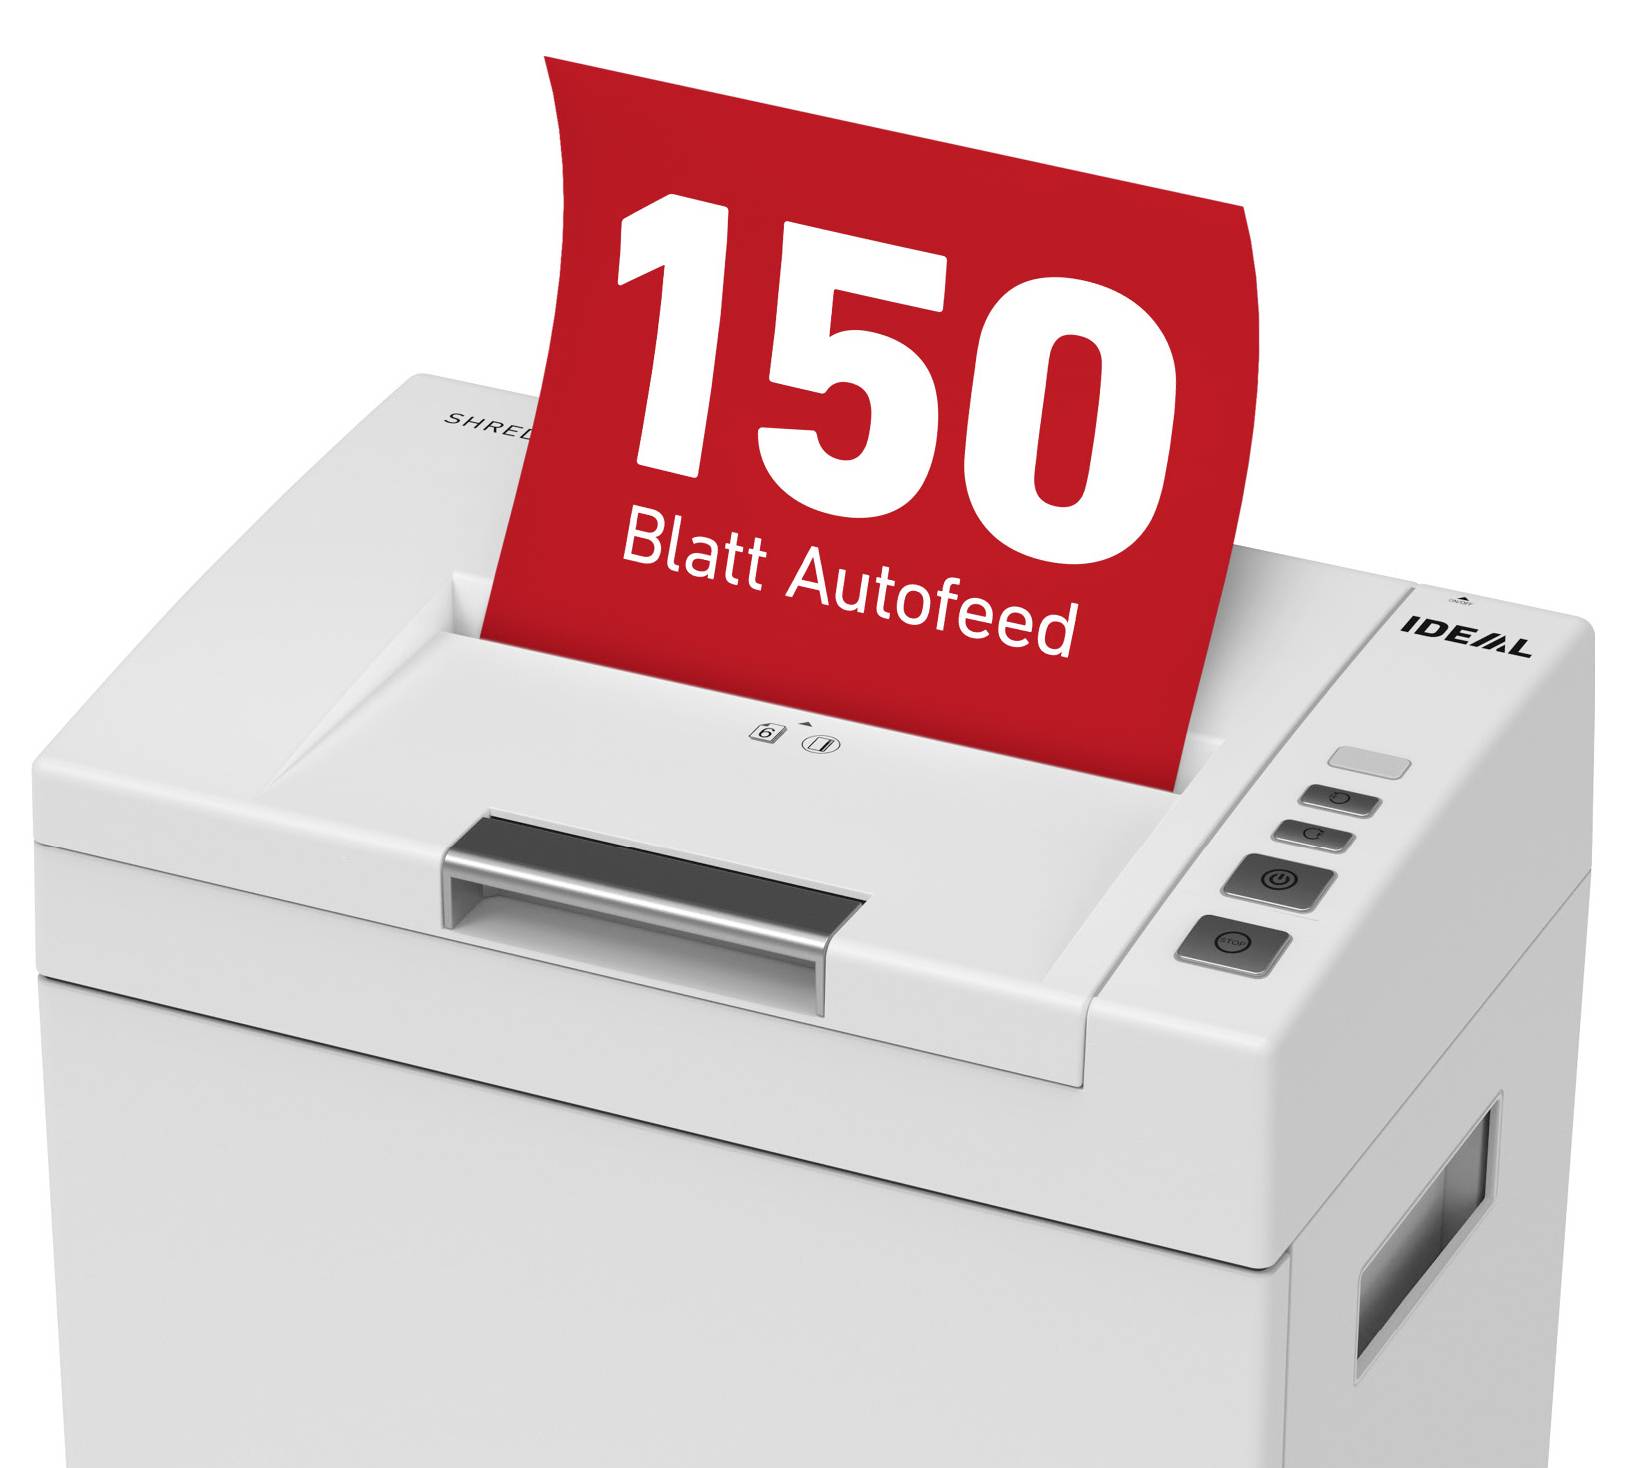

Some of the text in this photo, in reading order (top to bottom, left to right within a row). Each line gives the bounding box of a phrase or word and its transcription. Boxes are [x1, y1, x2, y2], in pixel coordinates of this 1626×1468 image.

[617, 193, 1177, 564] 150
[623, 504, 1079, 658] Blatt Autofeed
[1399, 615, 1533, 659] IDEAL
[758, 727, 776, 738] 6
